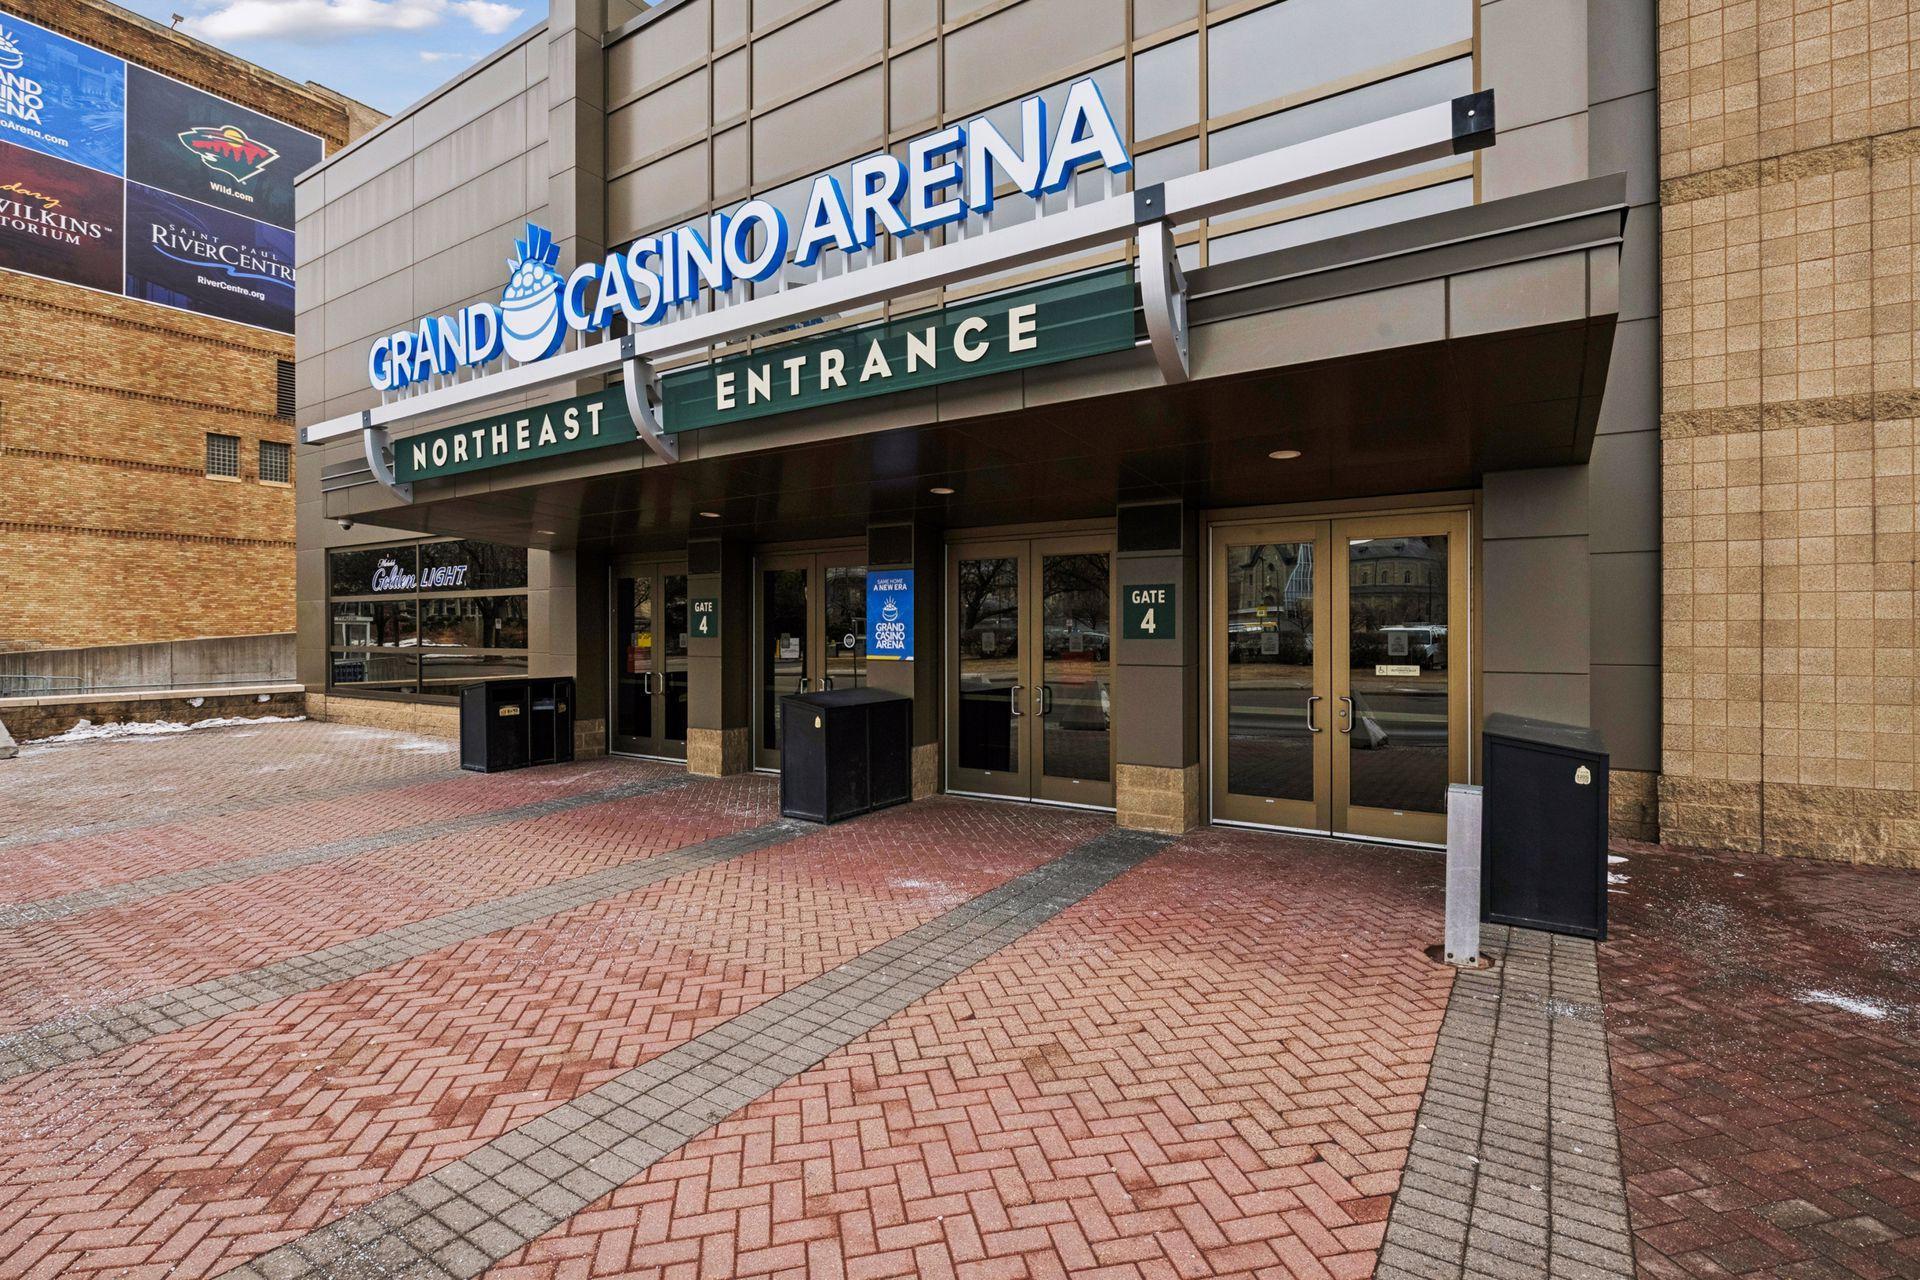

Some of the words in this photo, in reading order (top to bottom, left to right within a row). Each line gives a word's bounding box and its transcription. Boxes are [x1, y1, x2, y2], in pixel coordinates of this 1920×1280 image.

[210, 181, 254, 203] Wild.com
[169, 223, 219, 244] SAINT
[241, 244, 278, 261] PAUL
[368, 302, 502, 391] GRAND
[564, 199, 788, 332] CASINO
[794, 77, 1132, 267] ARENA
[197, 275, 265, 301] RiverCentre.org
[413, 402, 604, 471] NORTHEAST
[716, 304, 1038, 411] ENTRANCE
[372, 565, 417, 592] Golden
[420, 565, 467, 587] LIGHT
[894, 583, 907, 591] ERA
[694, 602, 713, 612] GATE
[1132, 590, 1166, 604] GATE
[699, 615, 708, 634] 4
[875, 622, 905, 632] GRAND
[1140, 608, 1156, 634] 4
[875, 631, 905, 641] CASINO
[875, 640, 905, 649] ARENA
